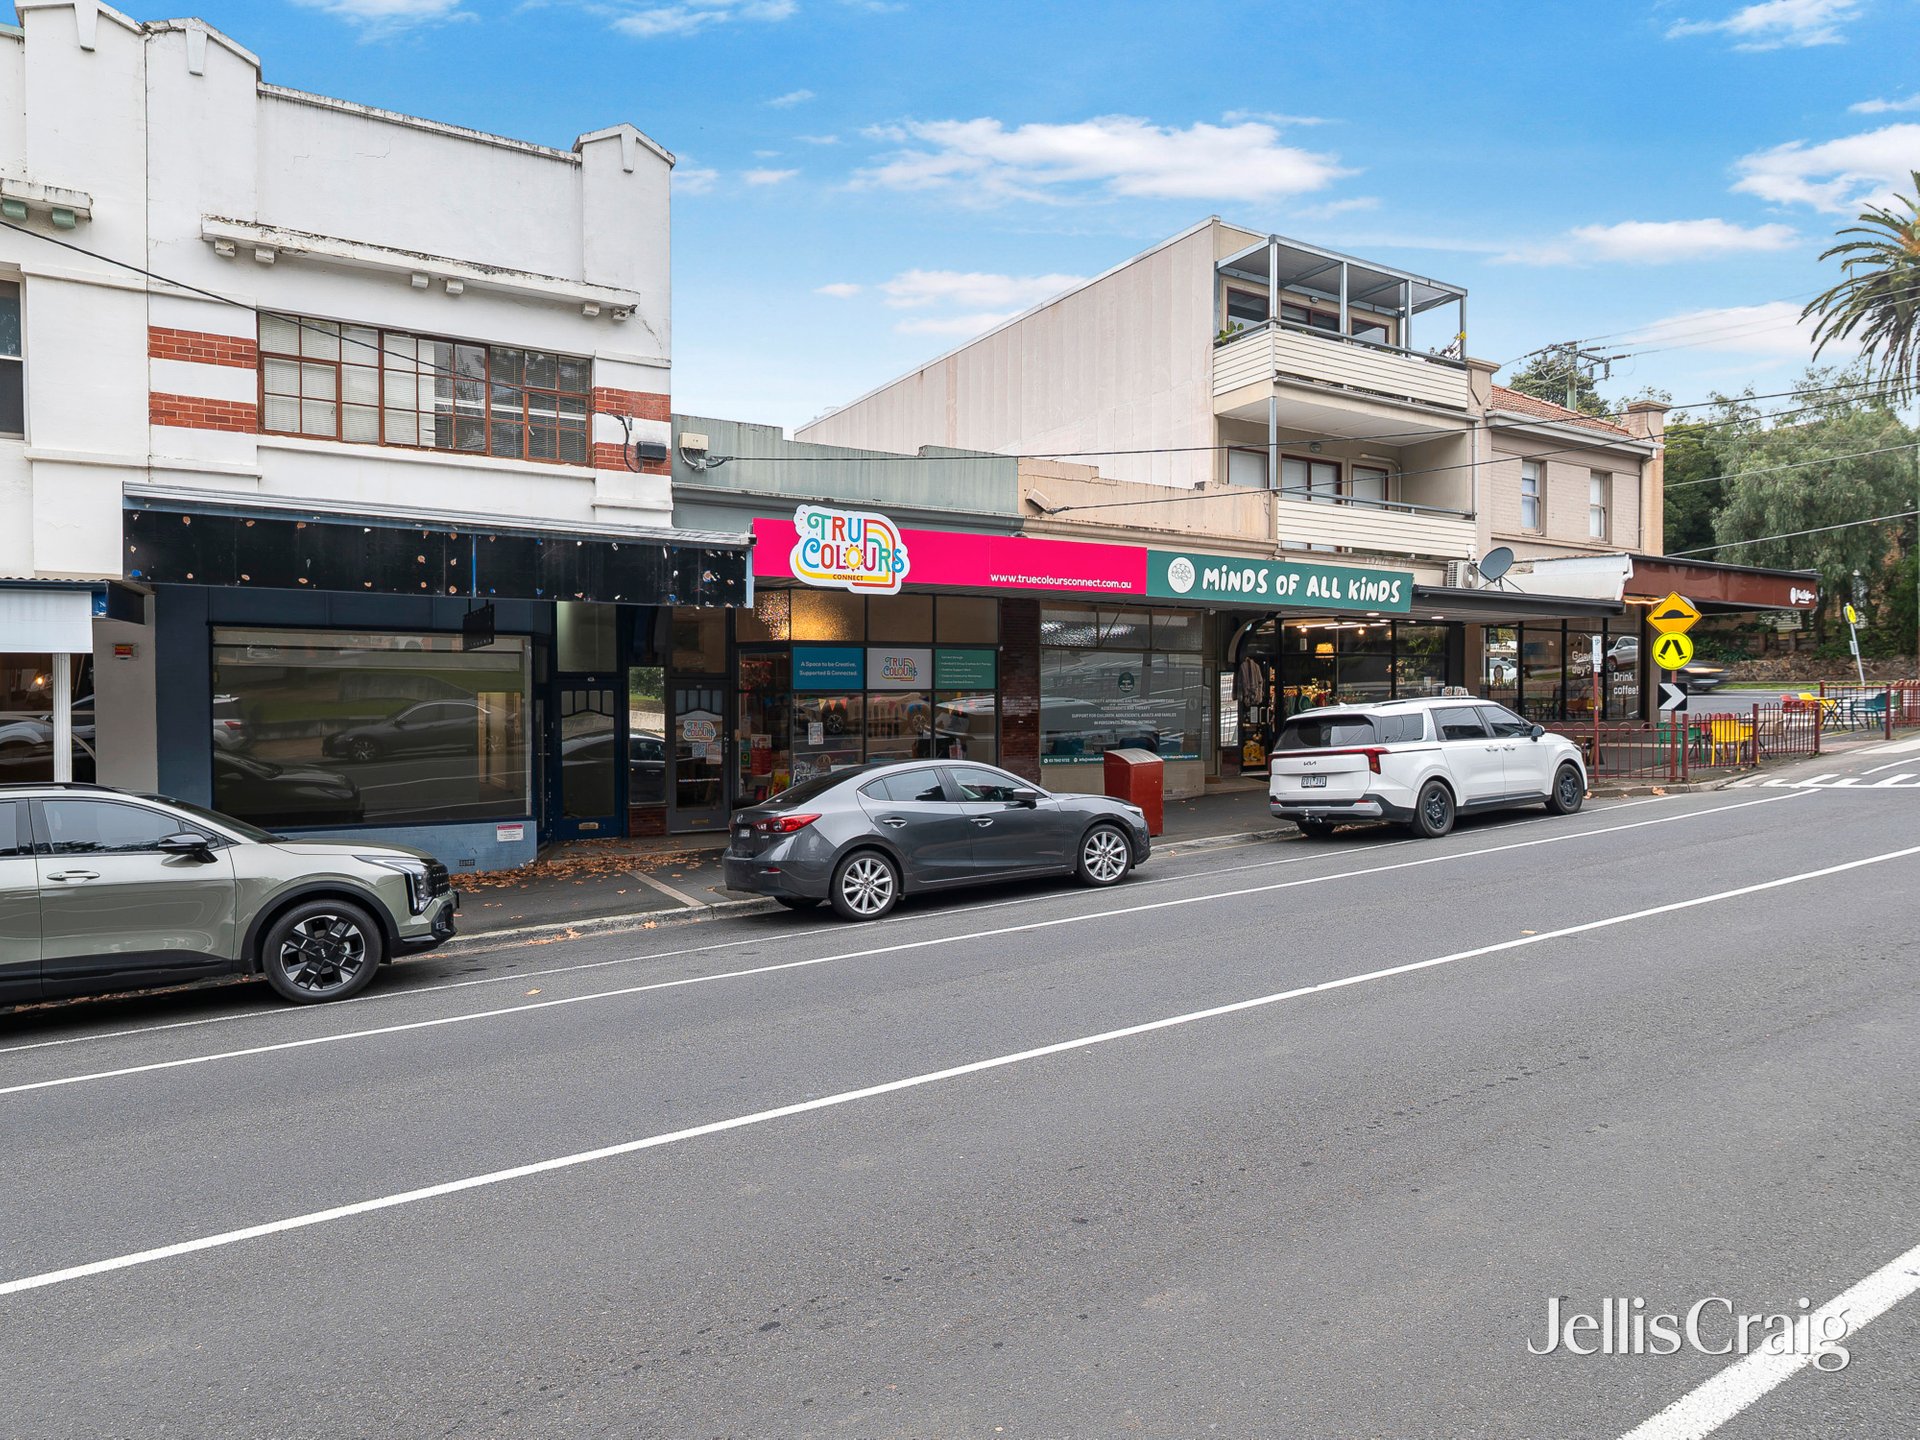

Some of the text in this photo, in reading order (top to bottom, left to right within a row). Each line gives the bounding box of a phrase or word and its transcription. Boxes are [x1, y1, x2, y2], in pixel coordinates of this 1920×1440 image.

[802, 538, 905, 573] COLOURS
[833, 573, 864, 581] CONNECT
[990, 573, 1132, 588] www.truecoloursconnect.com.au
[1275, 574, 1300, 596] OF
[1306, 575, 1342, 599] ALL
[1613, 672, 1633, 681] Drink
[1613, 685, 1639, 695] coffee!
